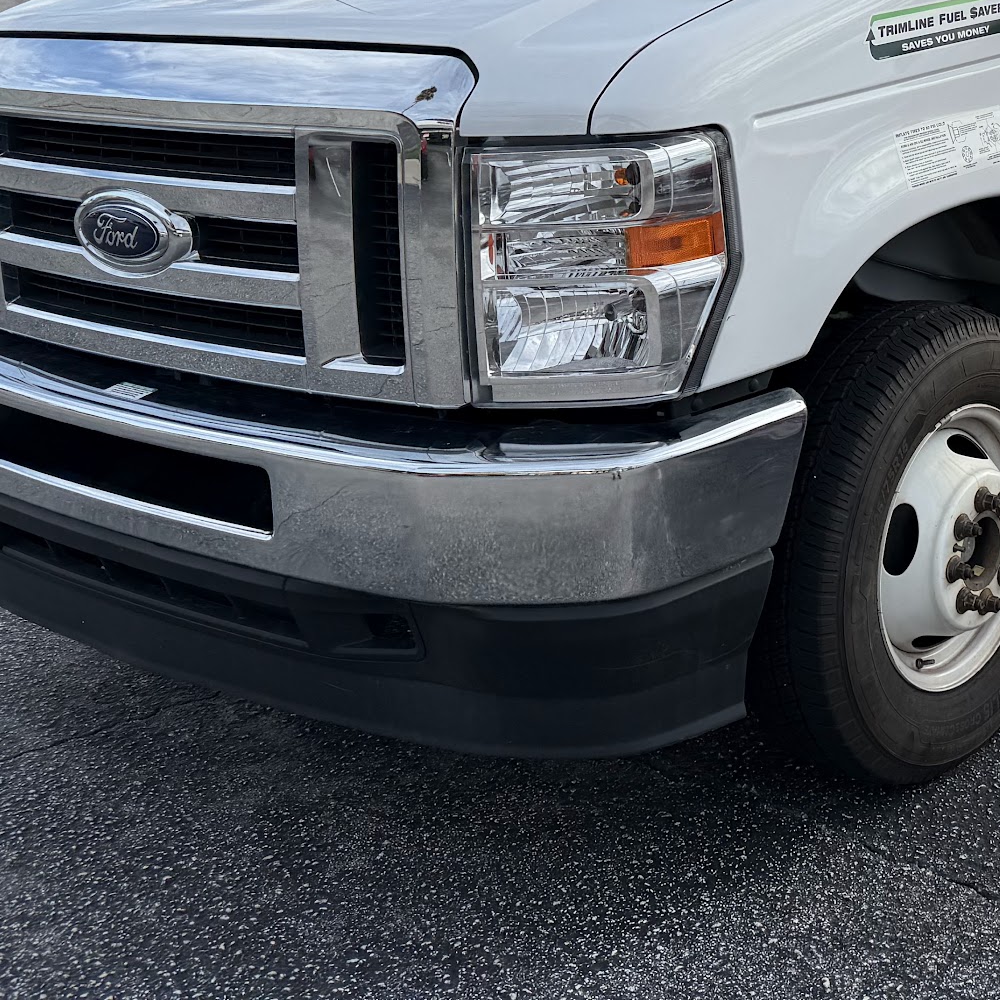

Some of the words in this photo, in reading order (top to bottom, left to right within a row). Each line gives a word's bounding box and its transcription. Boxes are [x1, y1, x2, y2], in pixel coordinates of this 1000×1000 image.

[878, 16, 935, 38] TRIMLINE
[939, 10, 967, 25] FUEL
[901, 37, 934, 52] SAVES
[935, 32, 955, 45] YOU
[957, 25, 990, 38] MONEY
[93, 212, 139, 249] Ford
